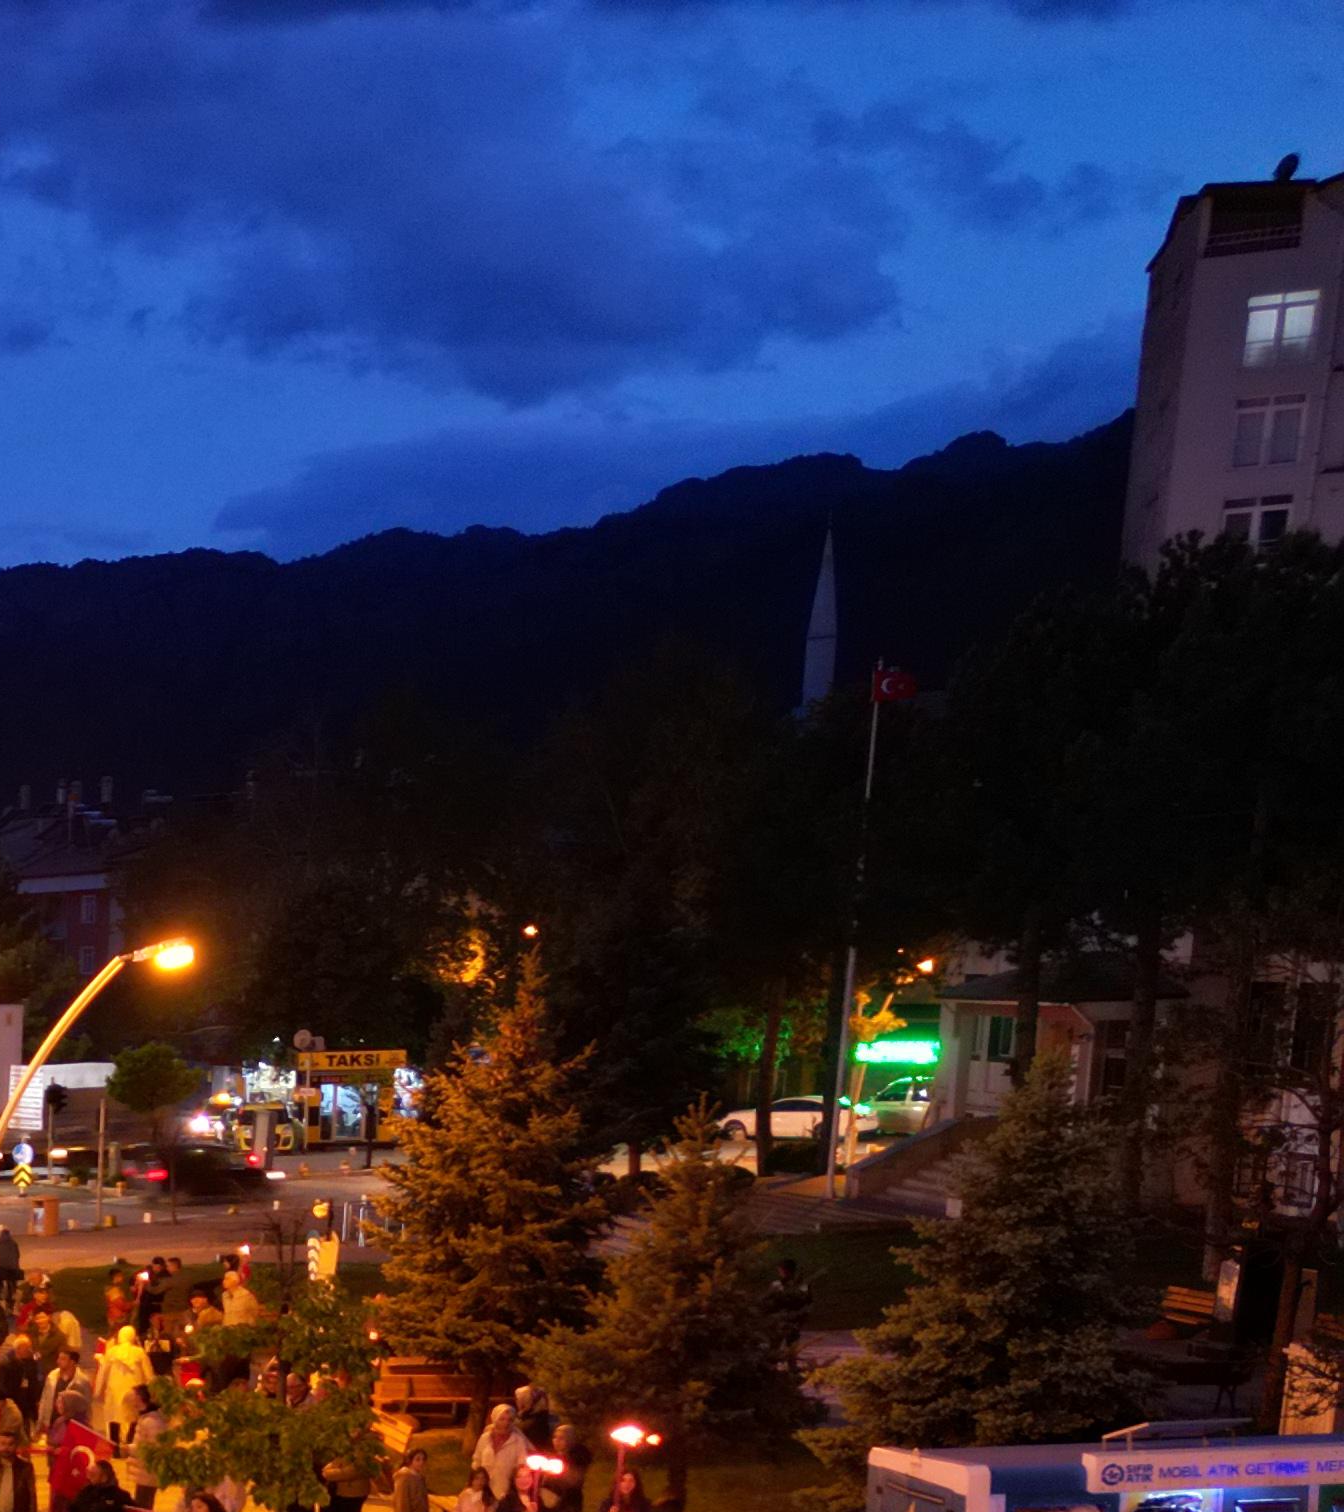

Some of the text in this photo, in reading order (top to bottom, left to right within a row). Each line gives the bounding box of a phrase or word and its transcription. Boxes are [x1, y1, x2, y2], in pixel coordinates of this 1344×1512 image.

[325, 1054, 380, 1067] TAKSİ
[1126, 1464, 1153, 1474] SIFIR
[1159, 1464, 1202, 1479] MOBİL
[1208, 1462, 1240, 1477] ATIK
[1245, 1460, 1309, 1476] GETİRME
[1126, 1473, 1153, 1483] ATIK
